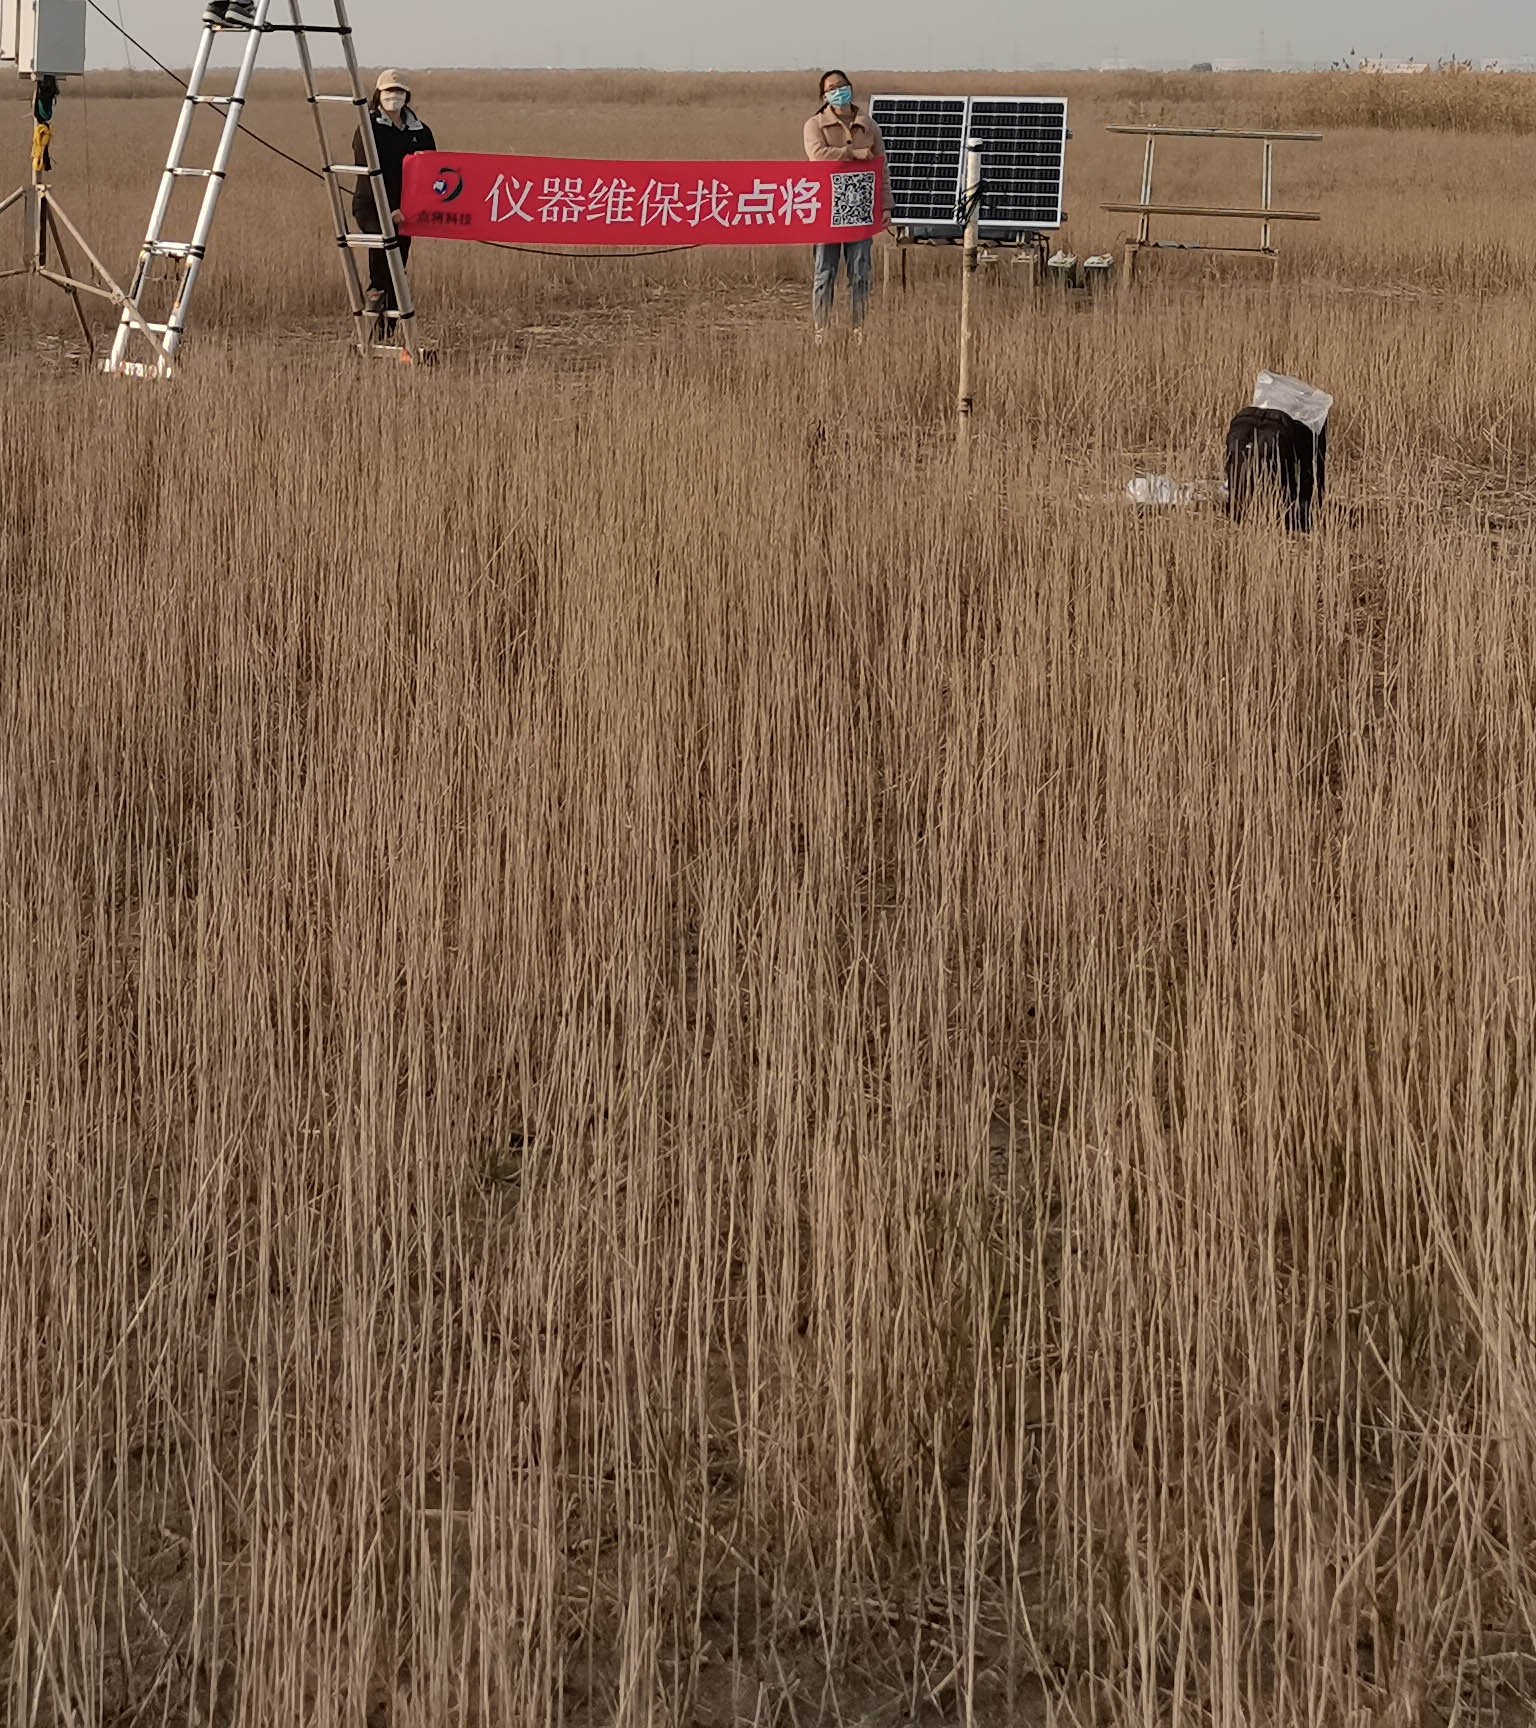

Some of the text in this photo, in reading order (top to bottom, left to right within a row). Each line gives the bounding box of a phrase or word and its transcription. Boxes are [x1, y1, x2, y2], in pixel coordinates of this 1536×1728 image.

[484, 173, 821, 227] 仪器维保找点将
